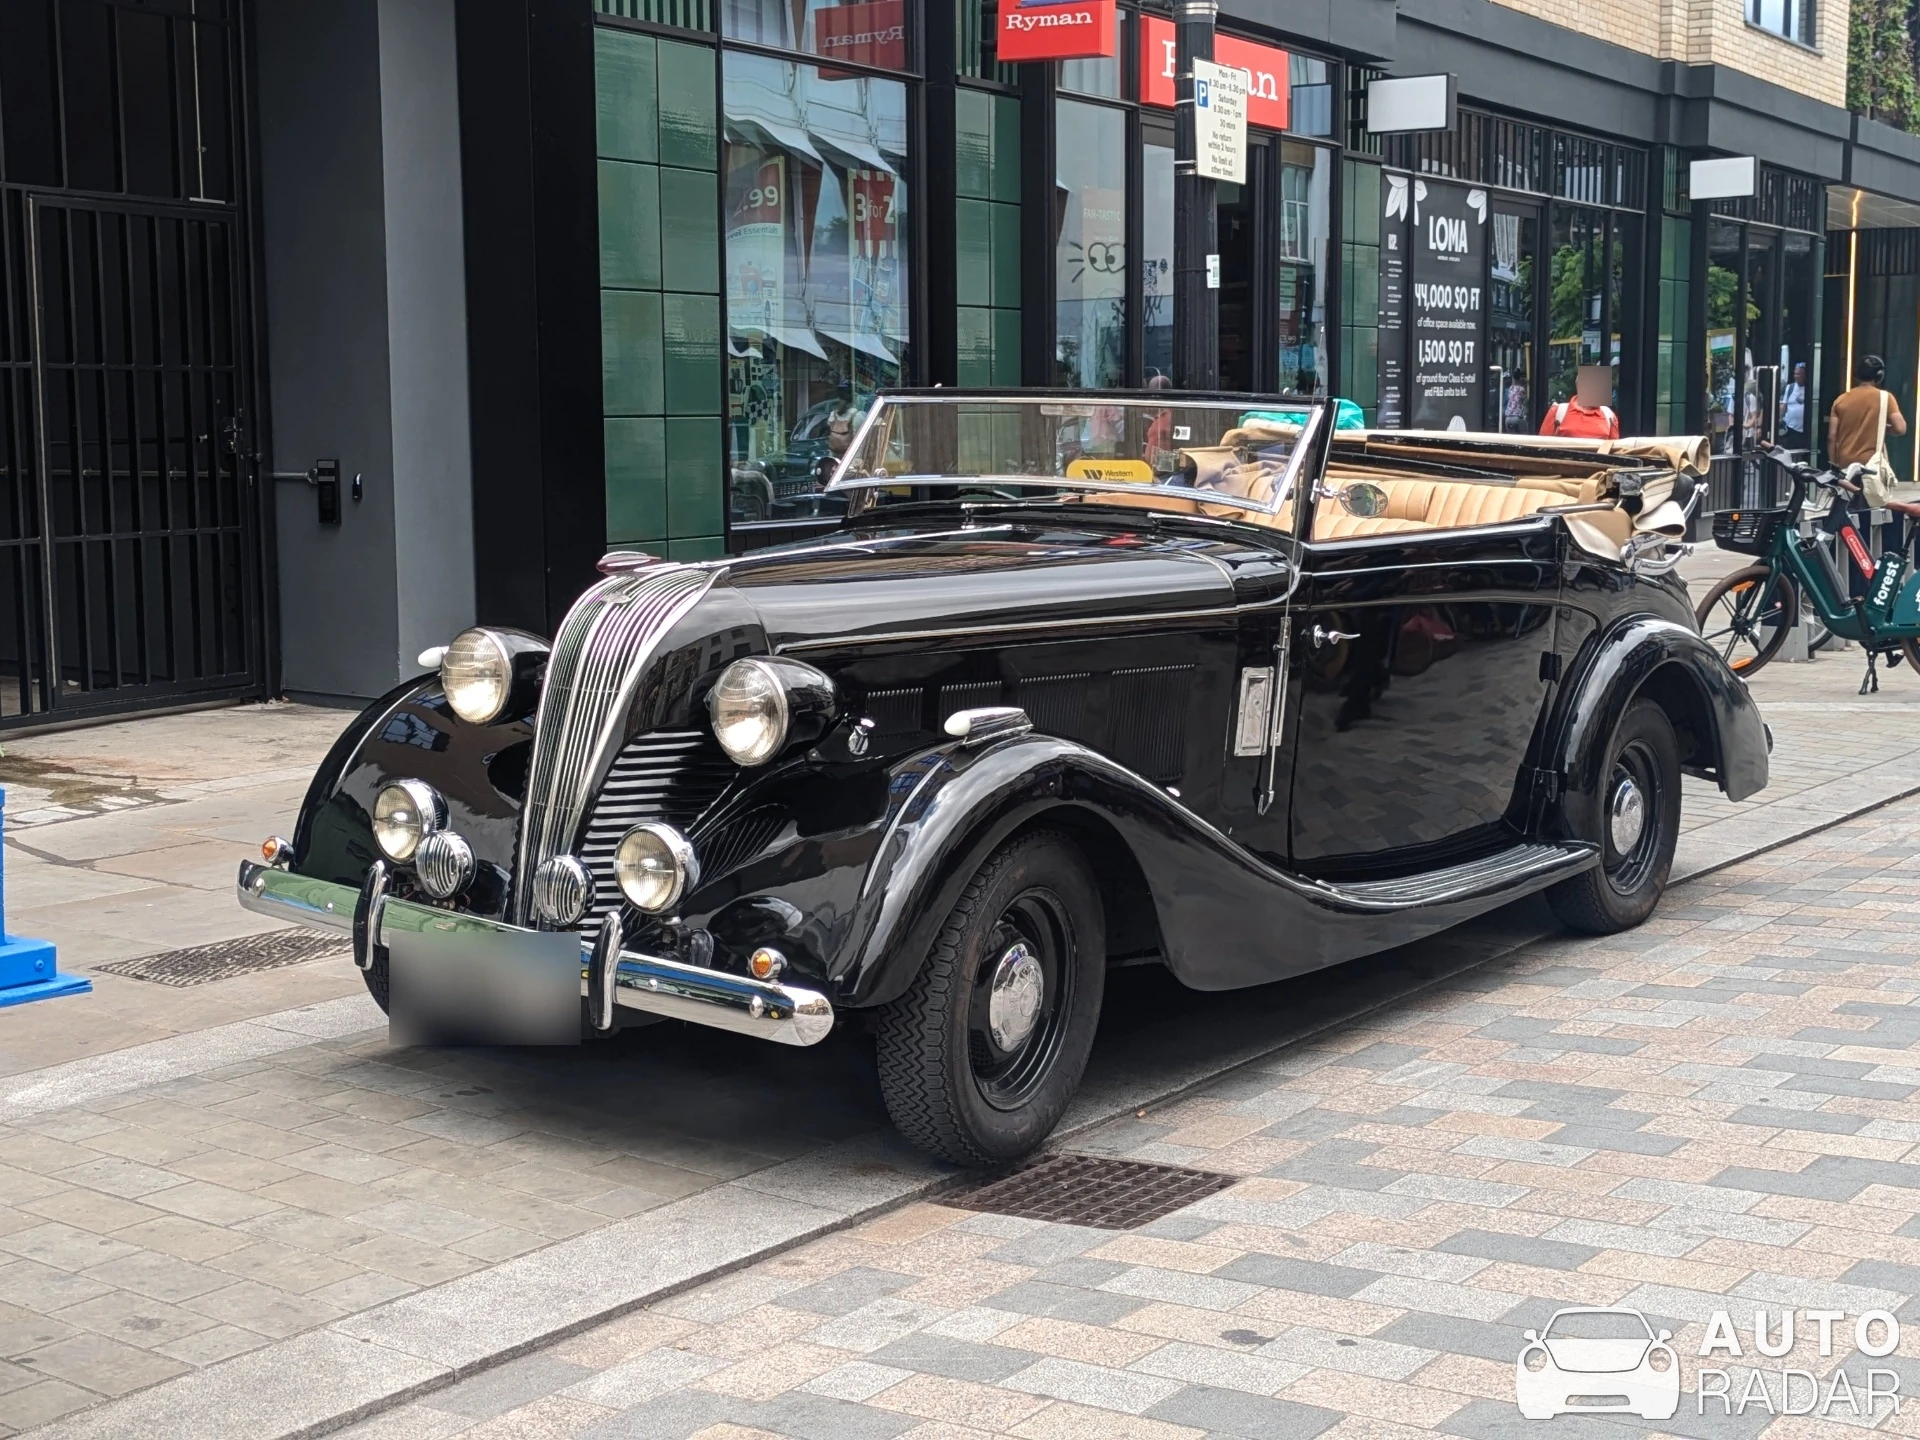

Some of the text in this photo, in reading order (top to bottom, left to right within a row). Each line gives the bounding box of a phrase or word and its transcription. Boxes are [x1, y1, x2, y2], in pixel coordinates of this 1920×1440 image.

[1005, 11, 1093, 32] Ryman
[1218, 69, 1228, 79] Mon
[1218, 93, 1238, 108] Saturday
[1226, 121, 1236, 131] mins
[1212, 130, 1232, 142] No return
[1208, 140, 1220, 151] within
[1225, 143, 1237, 154] hours
[1211, 154, 1218, 163] No
[1218, 155, 1228, 166] limit
[1211, 166, 1233, 177] other times
[855, 193, 895, 224] 3 for 2
[1429, 215, 1468, 254] LOMA
[1414, 283, 1452, 312] 44,000
[1454, 286, 1468, 313] SQ
[1470, 288, 1481, 311] FT
[1417, 316, 1424, 327] of
[1423, 316, 1435, 328] office
[1435, 320, 1449, 330] space
[1448, 318, 1466, 329] available
[1418, 339, 1475, 367] 1,500 SQ FT
[1415, 372, 1476, 386] of ground floor Class E retail
[1424, 386, 1433, 397] and
[1443, 386, 1455, 397] units
[1104, 469, 1134, 477] Western
[1873, 561, 1900, 606] forest
